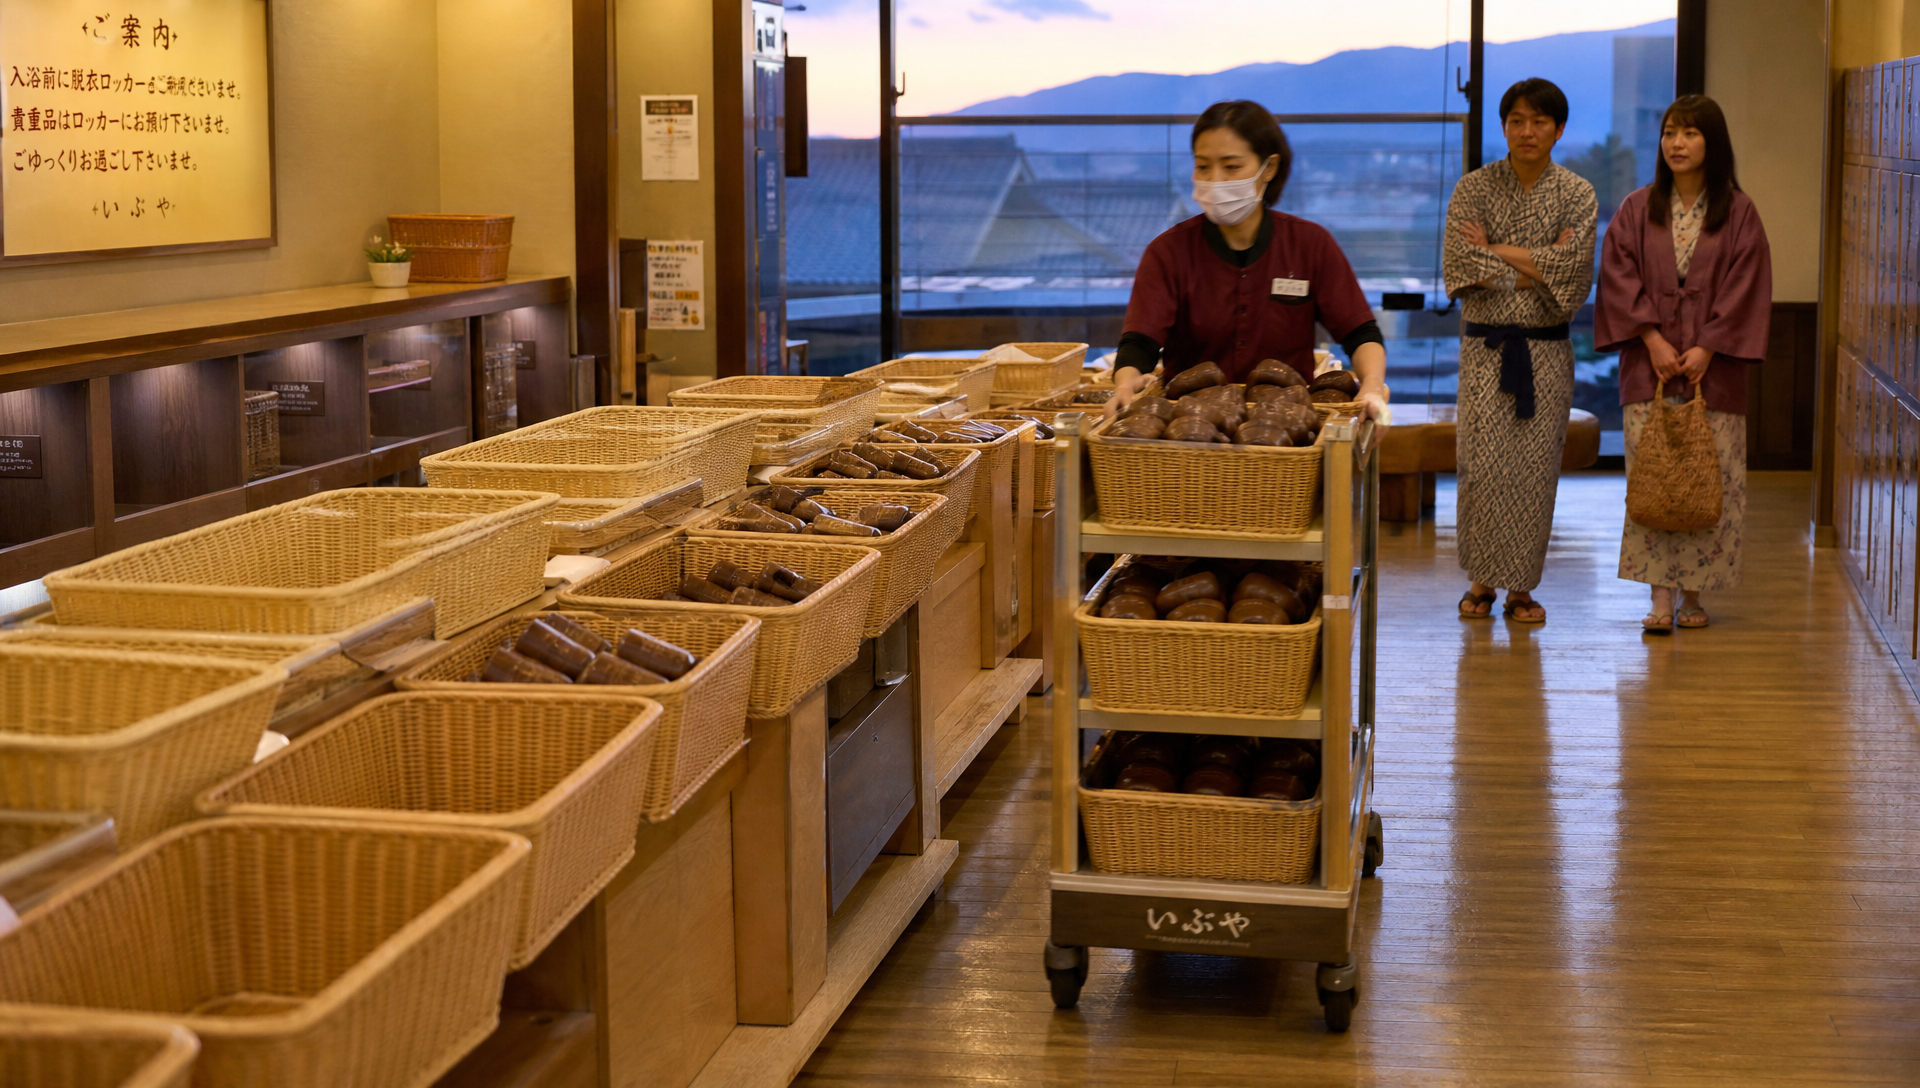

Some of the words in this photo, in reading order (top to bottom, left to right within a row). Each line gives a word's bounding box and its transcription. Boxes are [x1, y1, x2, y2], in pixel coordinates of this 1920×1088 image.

[11, 106, 230, 135] 貴重品はロッカーにお預け下さいませ。
[13, 148, 197, 173] ごゆっくりお過ごし下さいませ。
[102, 196, 170, 219] いぶや
[1146, 908, 1250, 938] いぶや
